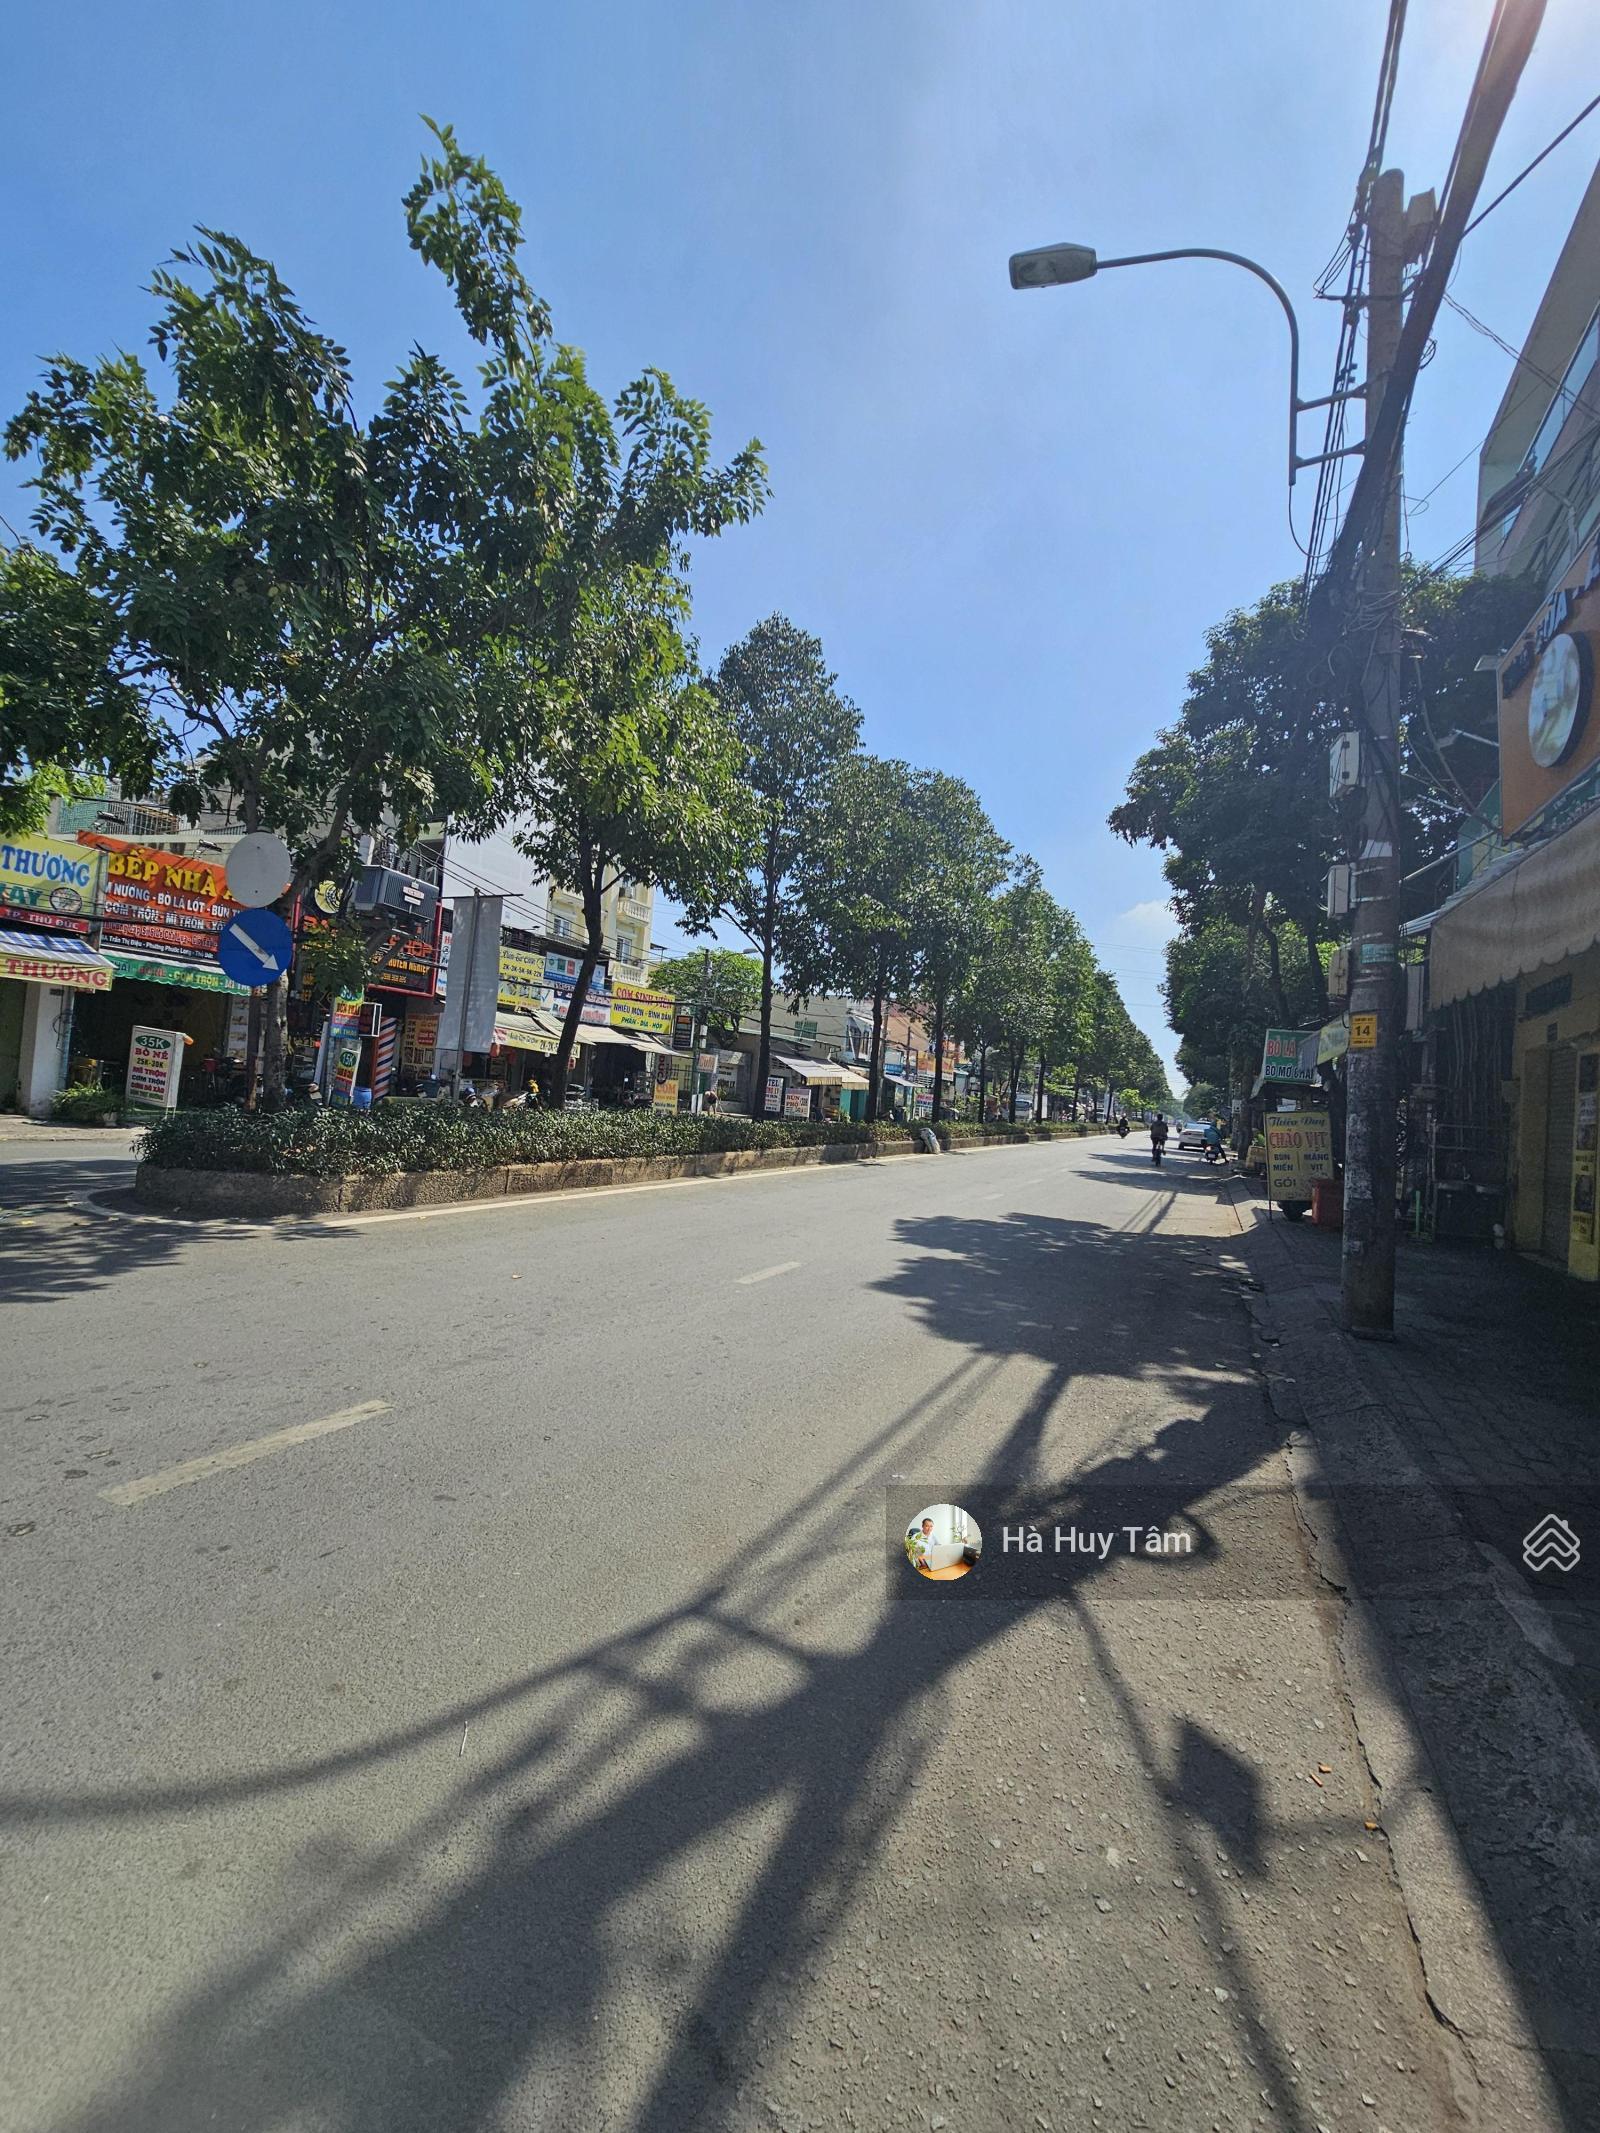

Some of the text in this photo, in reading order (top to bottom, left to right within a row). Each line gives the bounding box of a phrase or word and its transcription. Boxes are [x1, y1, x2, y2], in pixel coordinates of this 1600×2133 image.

[2, 844, 90, 888] THƯƠNG
[108, 848, 218, 898] BẾP NHÀ
[113, 883, 151, 902] NƯỚNG
[157, 891, 172, 906] BÒ
[173, 895, 185, 909] LÁ
[187, 896, 206, 913] LỐT
[211, 903, 230, 918] BÚN
[28, 911, 53, 925] THỦ
[55, 916, 80, 931] ĐỨC
[6, 957, 107, 987] THƯƠNG
[1355, 1025, 1371, 1037] 14
[140, 1036, 165, 1049] 35K
[135, 1047, 169, 1060] BÒ NÉ
[131, 1075, 146, 1083] CƠM
